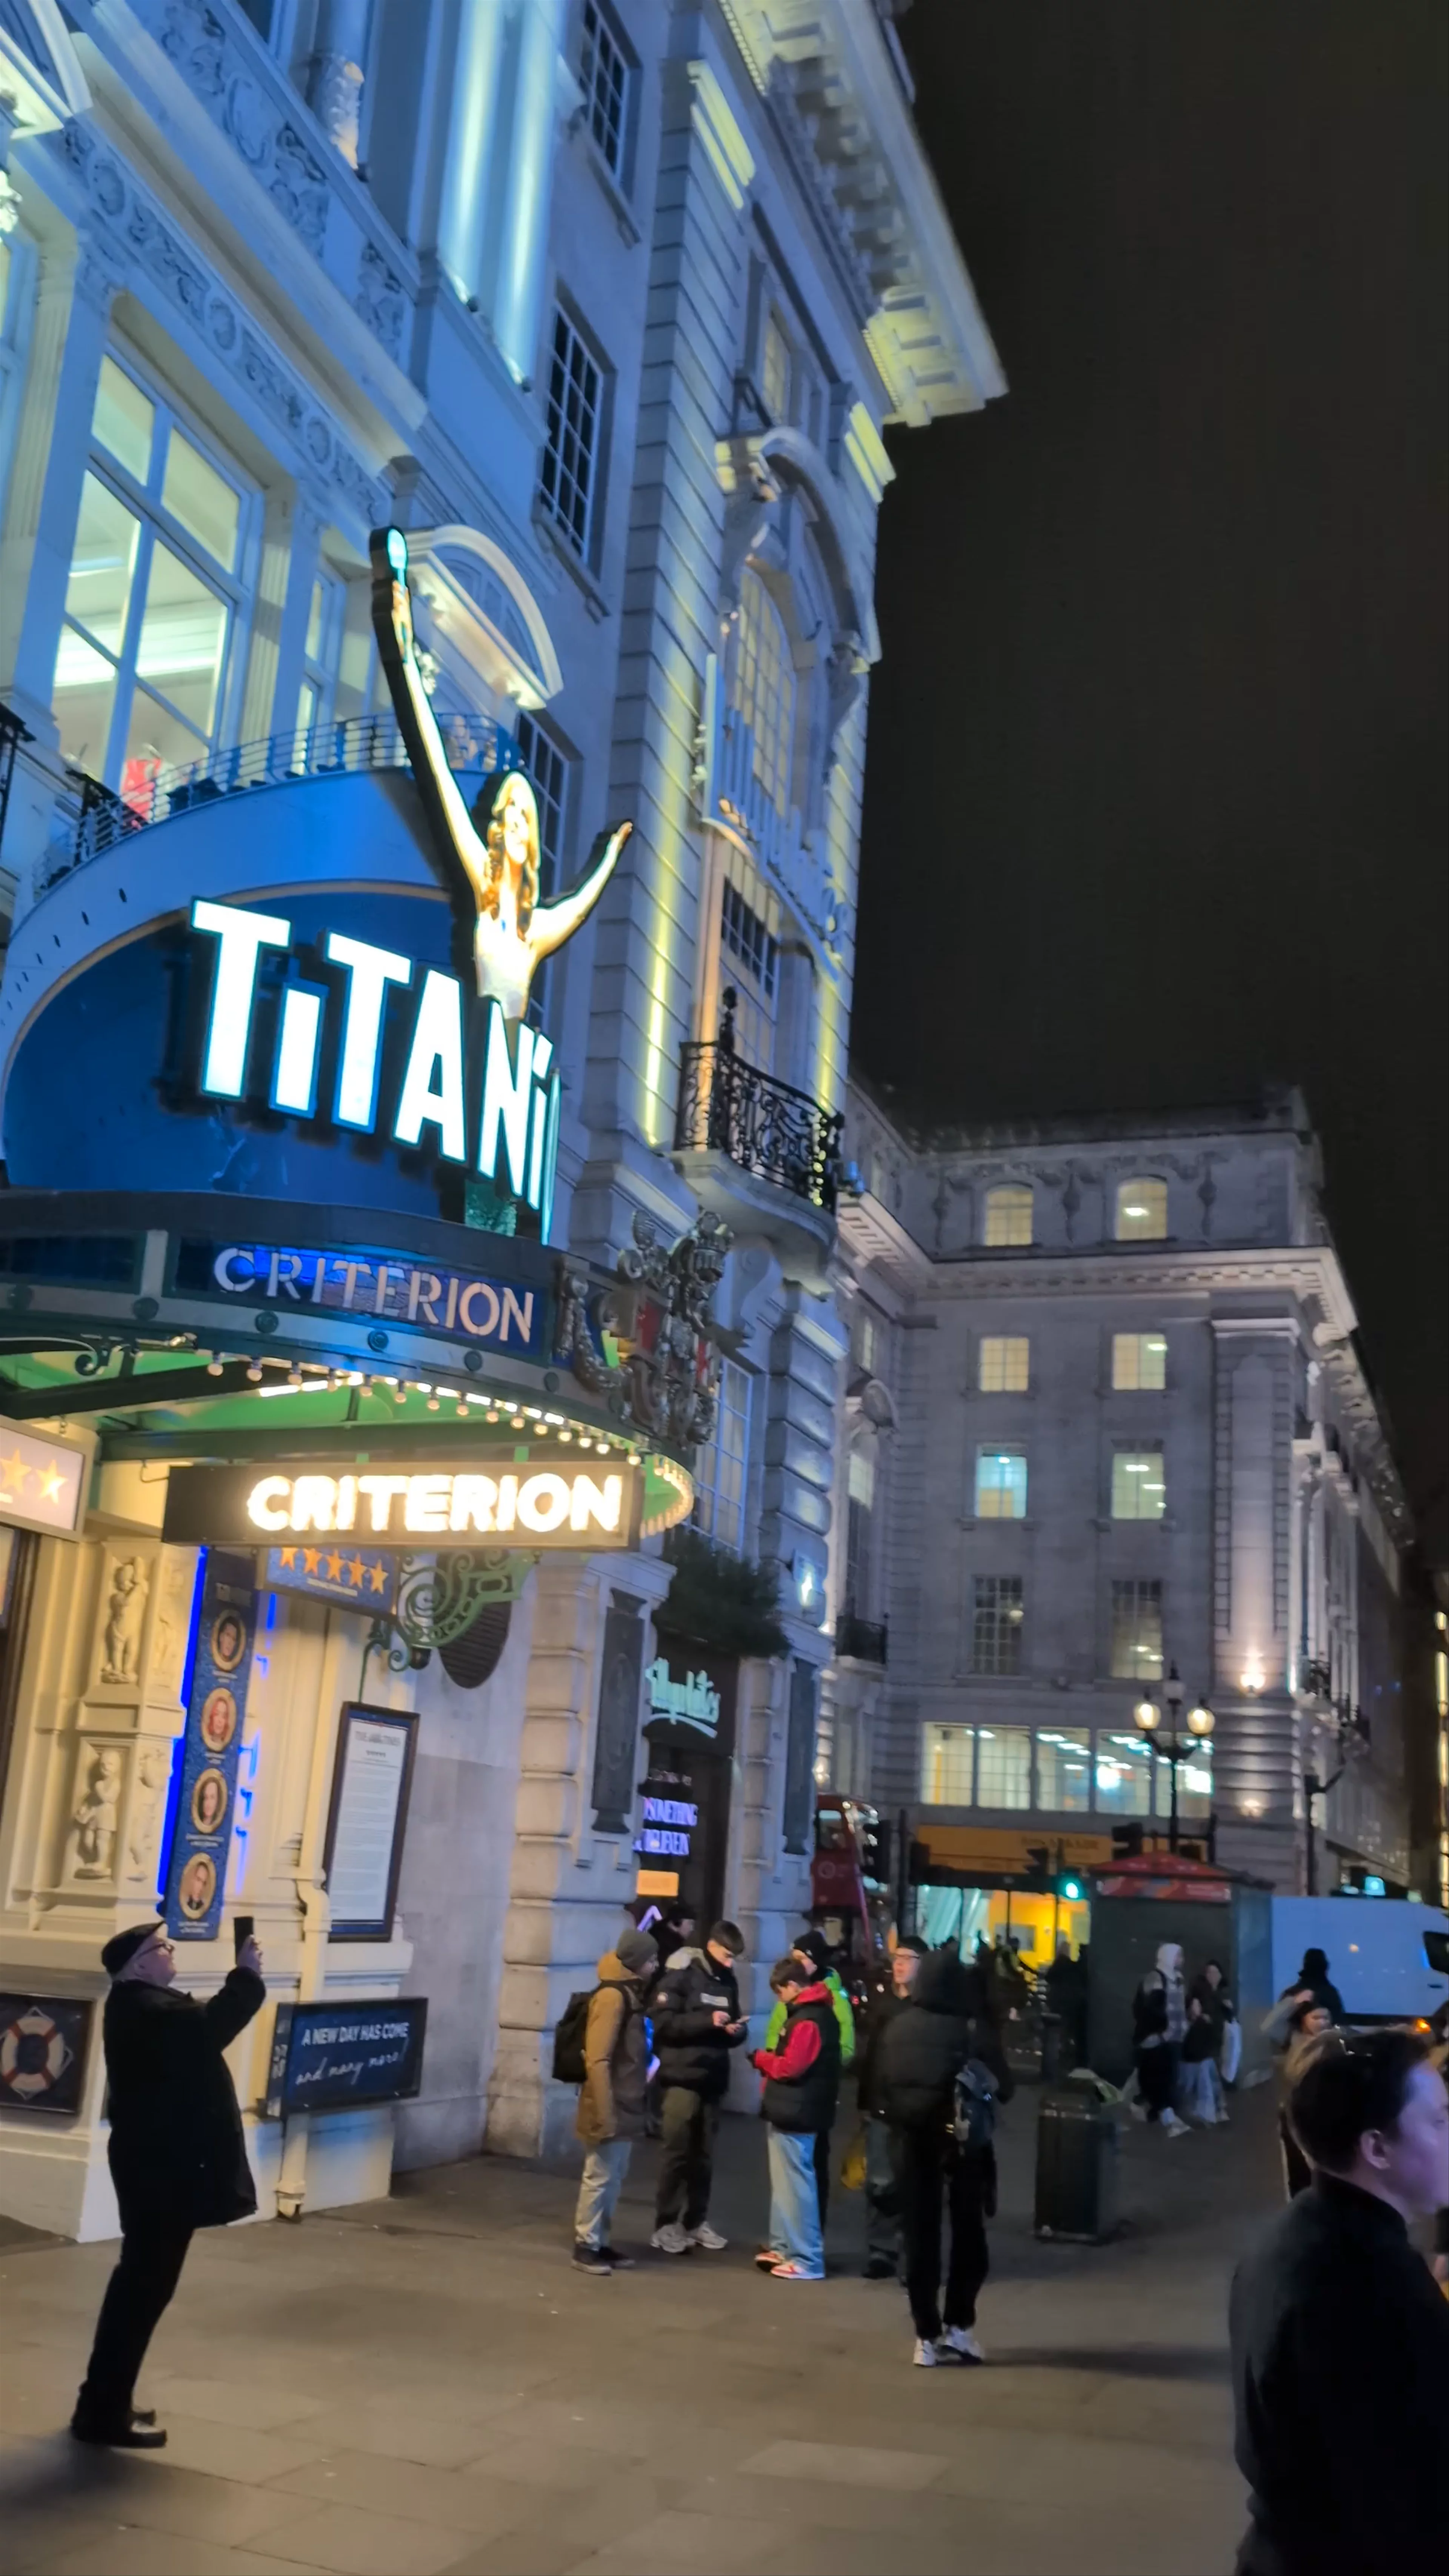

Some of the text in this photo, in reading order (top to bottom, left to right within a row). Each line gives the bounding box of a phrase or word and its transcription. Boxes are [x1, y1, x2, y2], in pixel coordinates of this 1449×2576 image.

[192, 898, 561, 1244] TiTANi
[214, 1247, 533, 1343] CRITERION
[248, 1473, 623, 1532] CRITERION
[301, 2022, 409, 2046] A NEW DAY HAS COME
[295, 2057, 328, 2085] and
[328, 2062, 364, 2085] many
